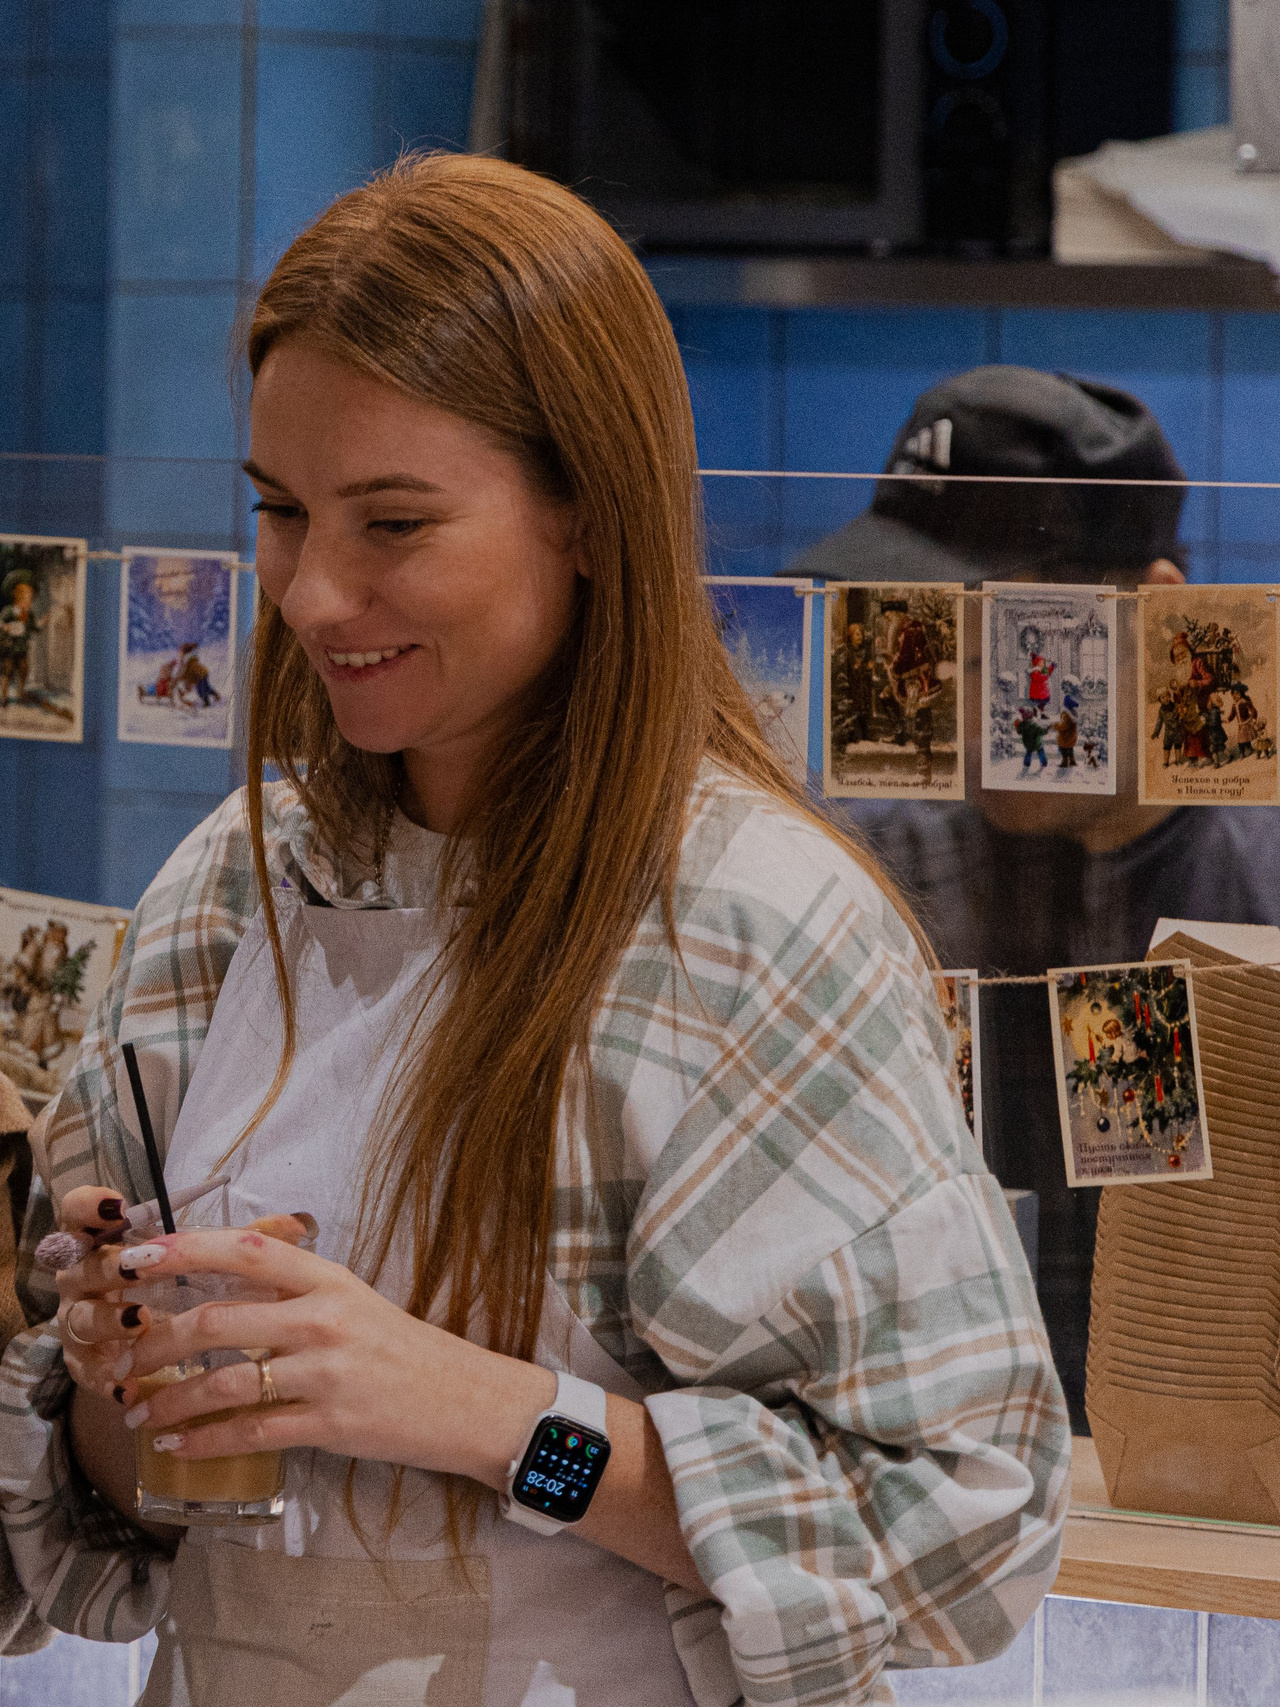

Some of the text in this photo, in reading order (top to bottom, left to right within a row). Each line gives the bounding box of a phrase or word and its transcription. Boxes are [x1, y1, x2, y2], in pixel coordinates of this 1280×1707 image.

[1172, 775, 1211, 784] Успехов
[1222, 775, 1251, 786] добра
[1219, 787, 1244, 797] году!
[526, 1471, 566, 1496] 20:28
